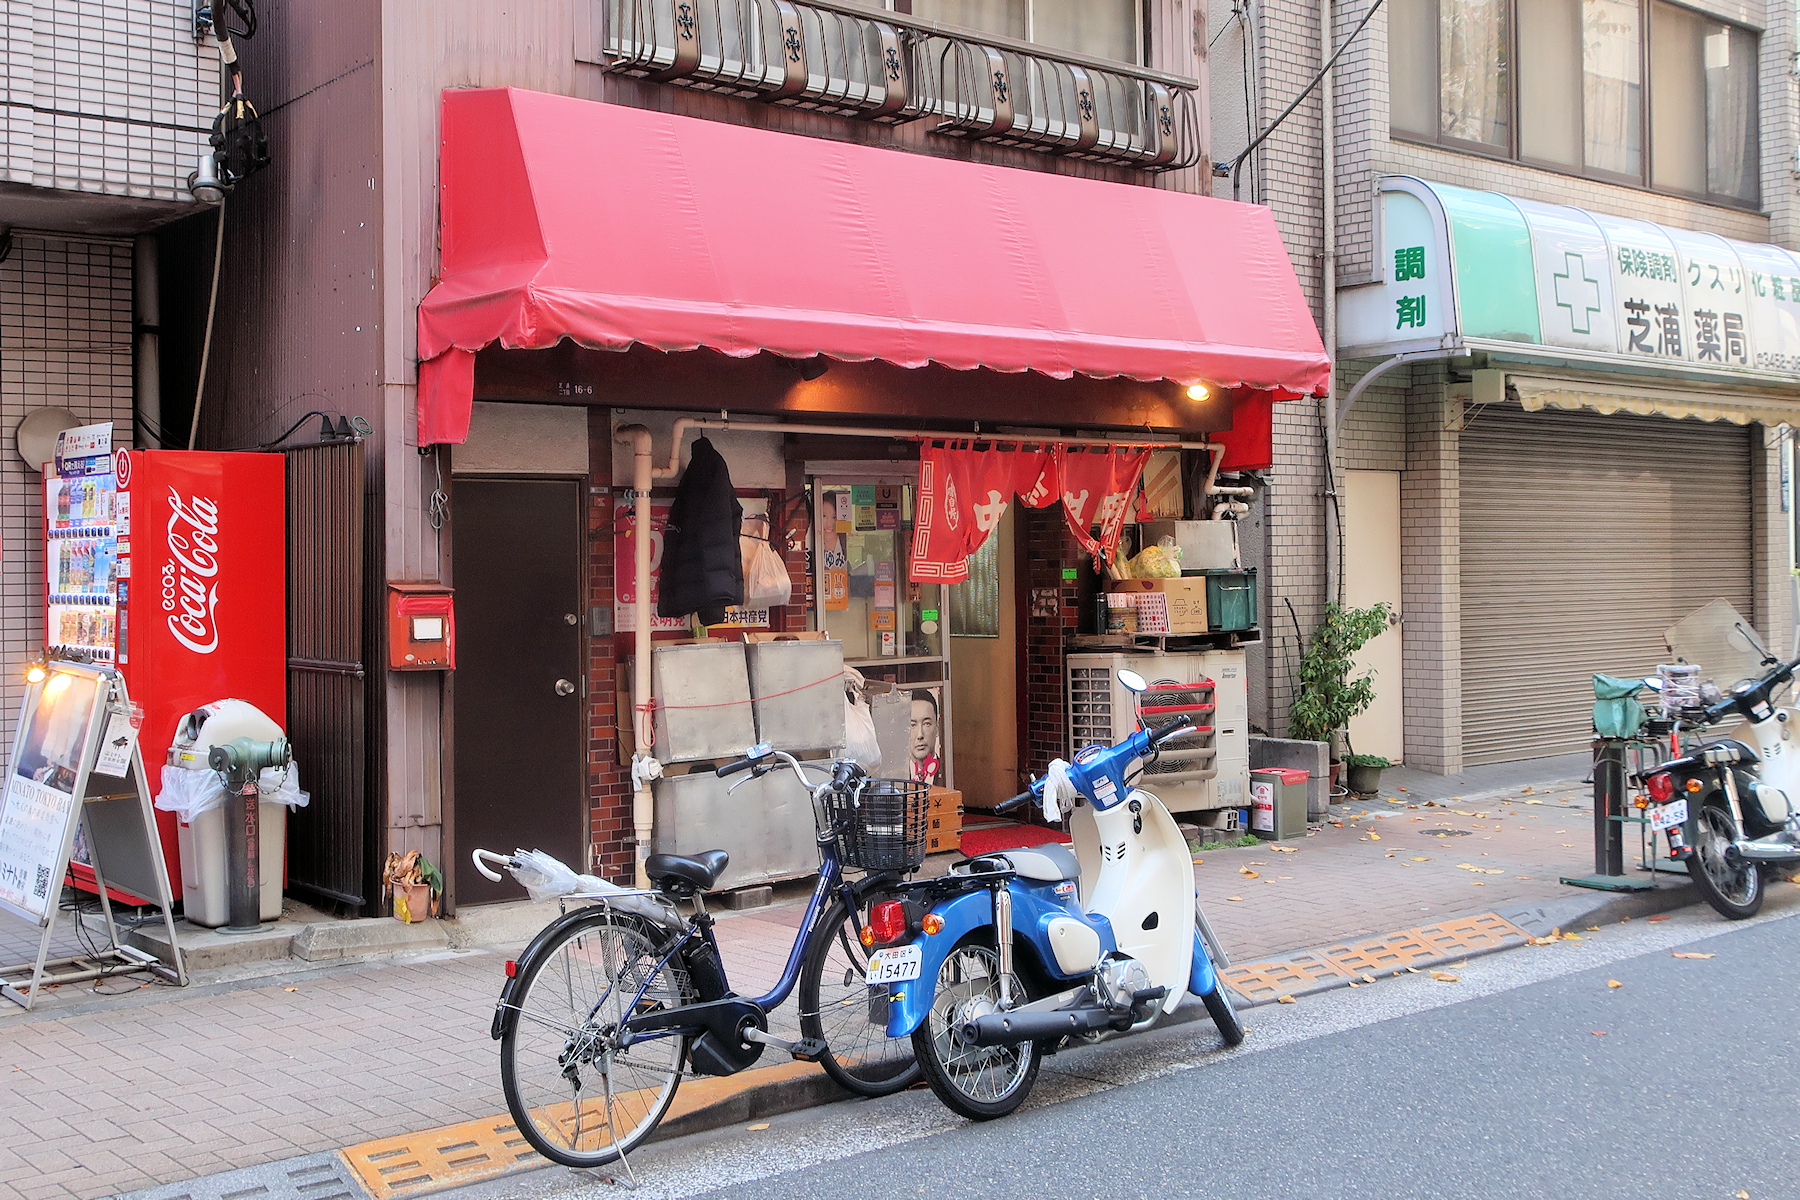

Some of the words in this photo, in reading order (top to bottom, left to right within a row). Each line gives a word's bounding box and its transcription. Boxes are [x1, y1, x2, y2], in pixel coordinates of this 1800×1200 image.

[1617, 246, 1677, 283] 保険調剤
[1688, 259, 1741, 294] クスリ
[1395, 246, 1425, 329] 調剤
[574, 384, 593, 395] 16-6
[168, 485, 219, 653] Coca-Cola
[10, 779, 34, 800] MINATO
[35, 788, 57, 809] TOKYO
[245, 798, 256, 836] 送水口
[879, 961, 917, 979] 15477
[884, 950, 906, 960] 大田区
